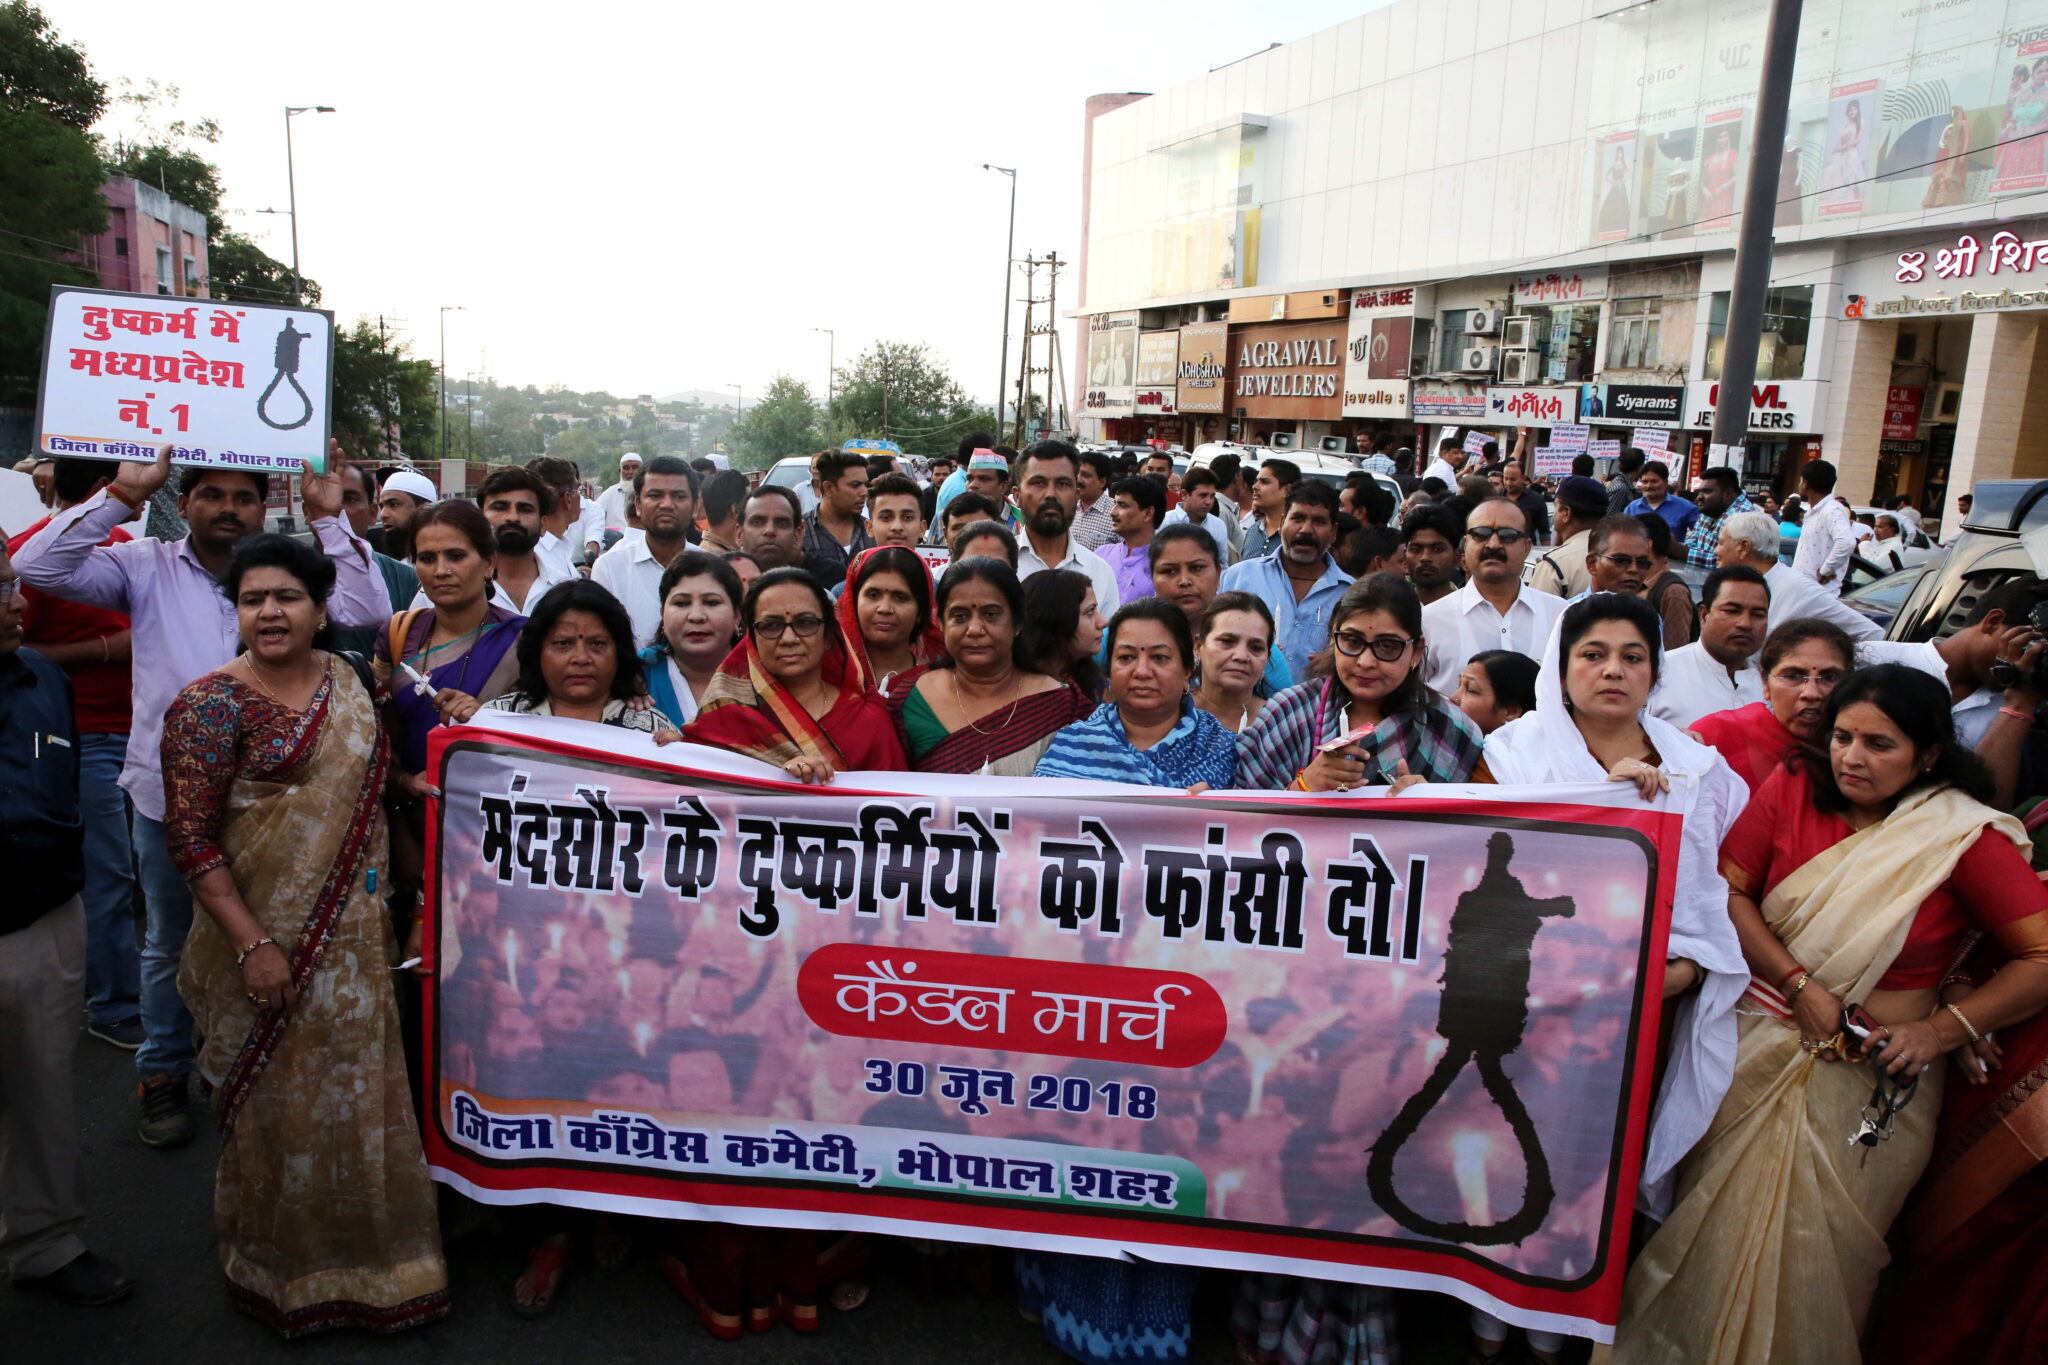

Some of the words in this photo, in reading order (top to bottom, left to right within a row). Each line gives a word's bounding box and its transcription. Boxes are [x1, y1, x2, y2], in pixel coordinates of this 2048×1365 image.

[1934, 235, 1980, 278] श्री
[81, 305, 199, 341] दुष्कर्म
[209, 310, 246, 344] में
[69, 347, 245, 389] मध्यप्रदेश
[1239, 338, 1338, 368] AGRAWAL
[1236, 373, 1337, 398] JEWELLERS
[1621, 419, 1667, 428] NEERAJ
[50, 437, 98, 454] जिला
[220, 451, 271, 467] भोपाल
[481, 772, 653, 898] मंदसौर
[662, 795, 726, 902] के
[737, 802, 1012, 940] दुष्कर्मियों
[1039, 816, 1129, 938] को
[1142, 823, 1314, 953] फांसी
[833, 959, 1015, 1034] कैंडल
[1031, 983, 1193, 1050] मार्च
[864, 1058, 925, 1096] 30
[938, 1064, 1018, 1116] जून
[1028, 1073, 1158, 1121] 2018
[454, 1095, 554, 1150] जिला
[723, 1129, 878, 1183] कमेटी,
[898, 1141, 1056, 1194] भोपाल
[1069, 1164, 1177, 1205] शहर
